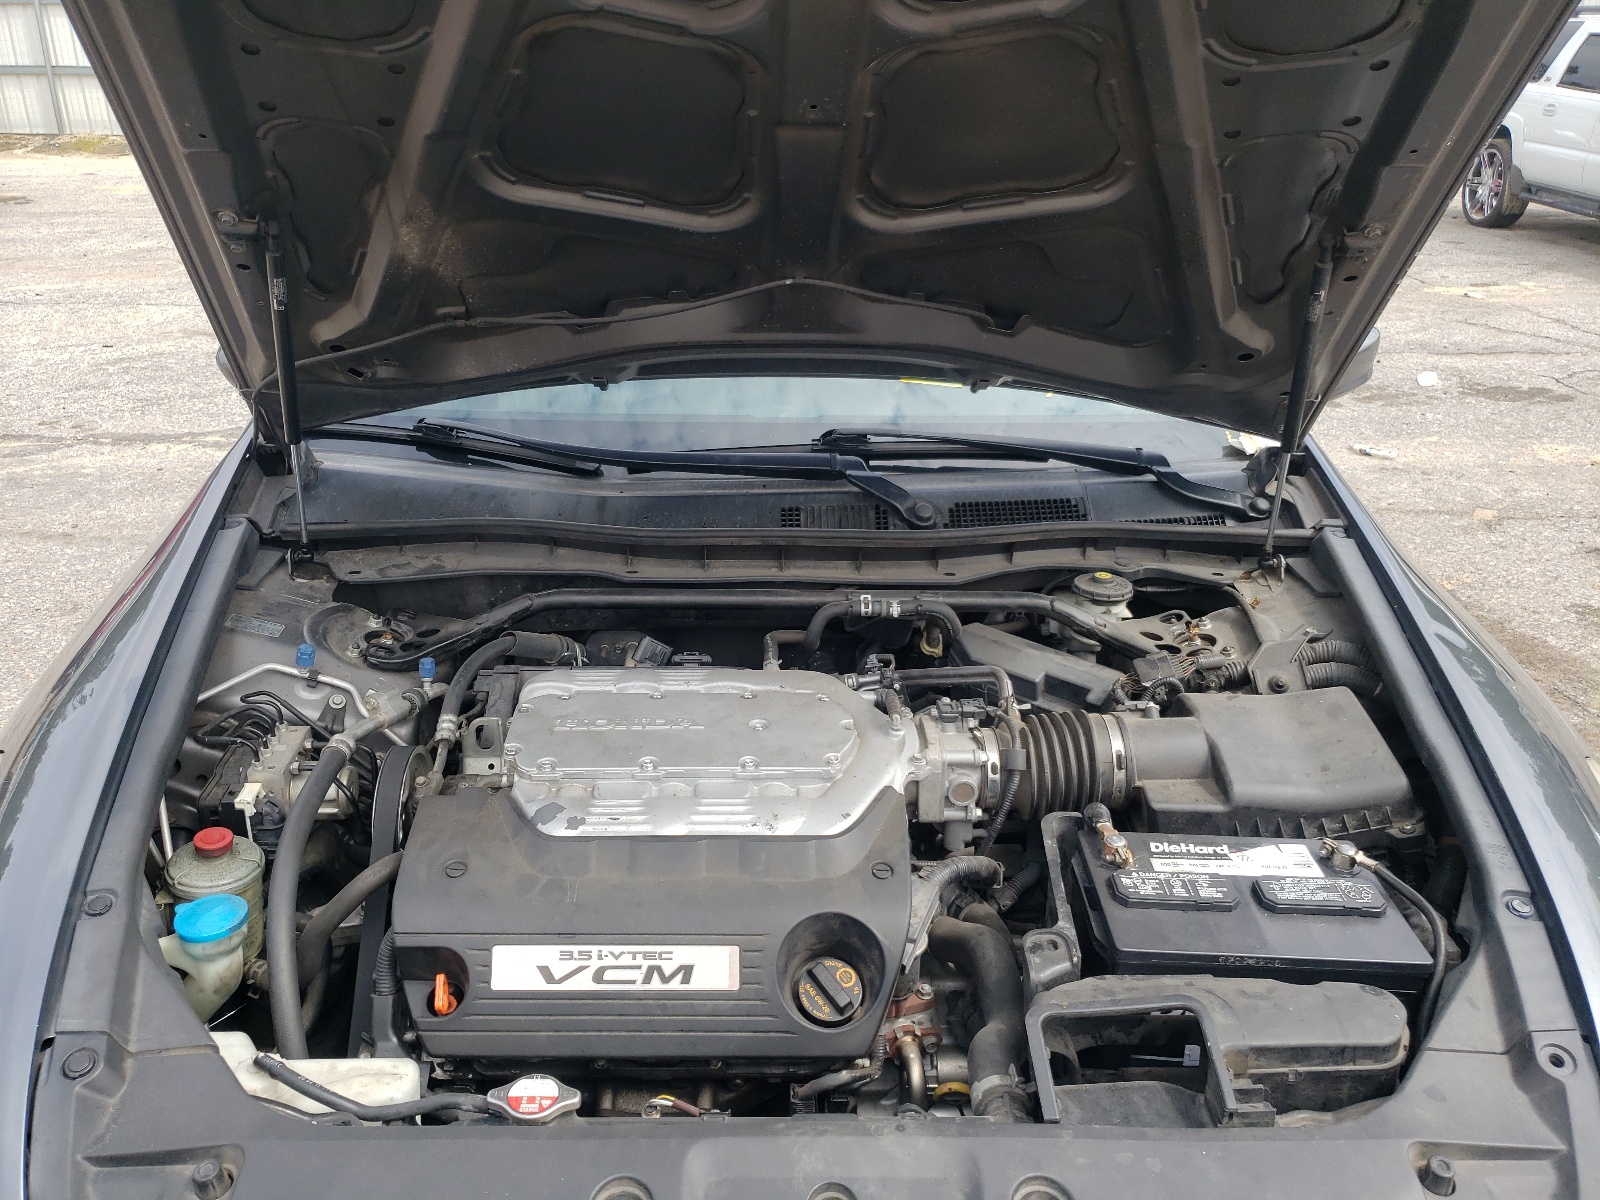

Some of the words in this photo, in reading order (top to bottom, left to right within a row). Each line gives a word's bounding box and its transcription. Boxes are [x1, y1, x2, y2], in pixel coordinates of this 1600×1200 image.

[553, 718, 704, 732] HONDA
[1149, 841, 1230, 854] DieHard
[558, 949, 593, 961] 3.5
[596, 949, 674, 961] i-VTEC
[535, 964, 695, 985] VCM
[805, 983, 816, 996] SAE
